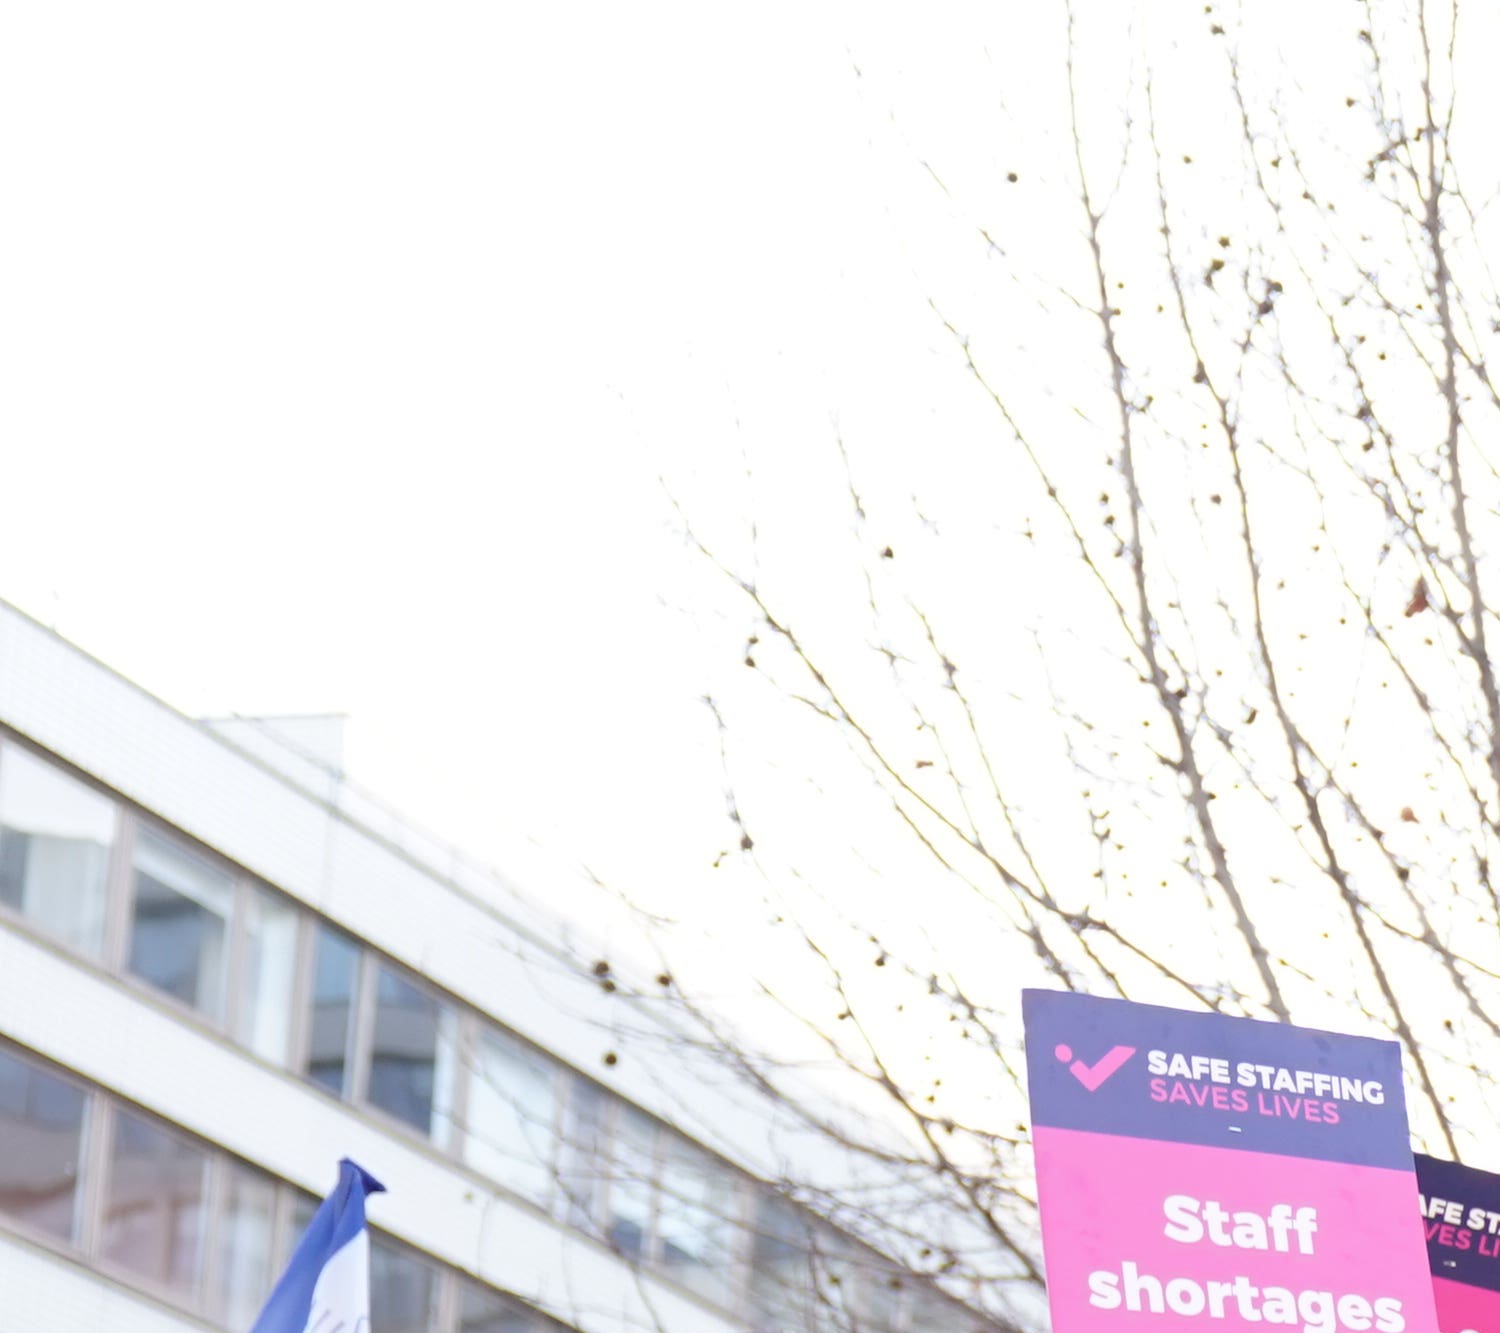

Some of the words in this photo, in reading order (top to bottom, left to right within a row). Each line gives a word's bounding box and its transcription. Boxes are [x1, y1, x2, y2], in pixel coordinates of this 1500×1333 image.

[1147, 1050, 1231, 1084] SAFE
[1237, 1063, 1385, 1105] STAFFING
[1150, 1079, 1249, 1112] SAVES
[1258, 1093, 1341, 1125] LIVES
[1163, 1195, 1318, 1255] Staff
[1422, 1220, 1472, 1250] VES
